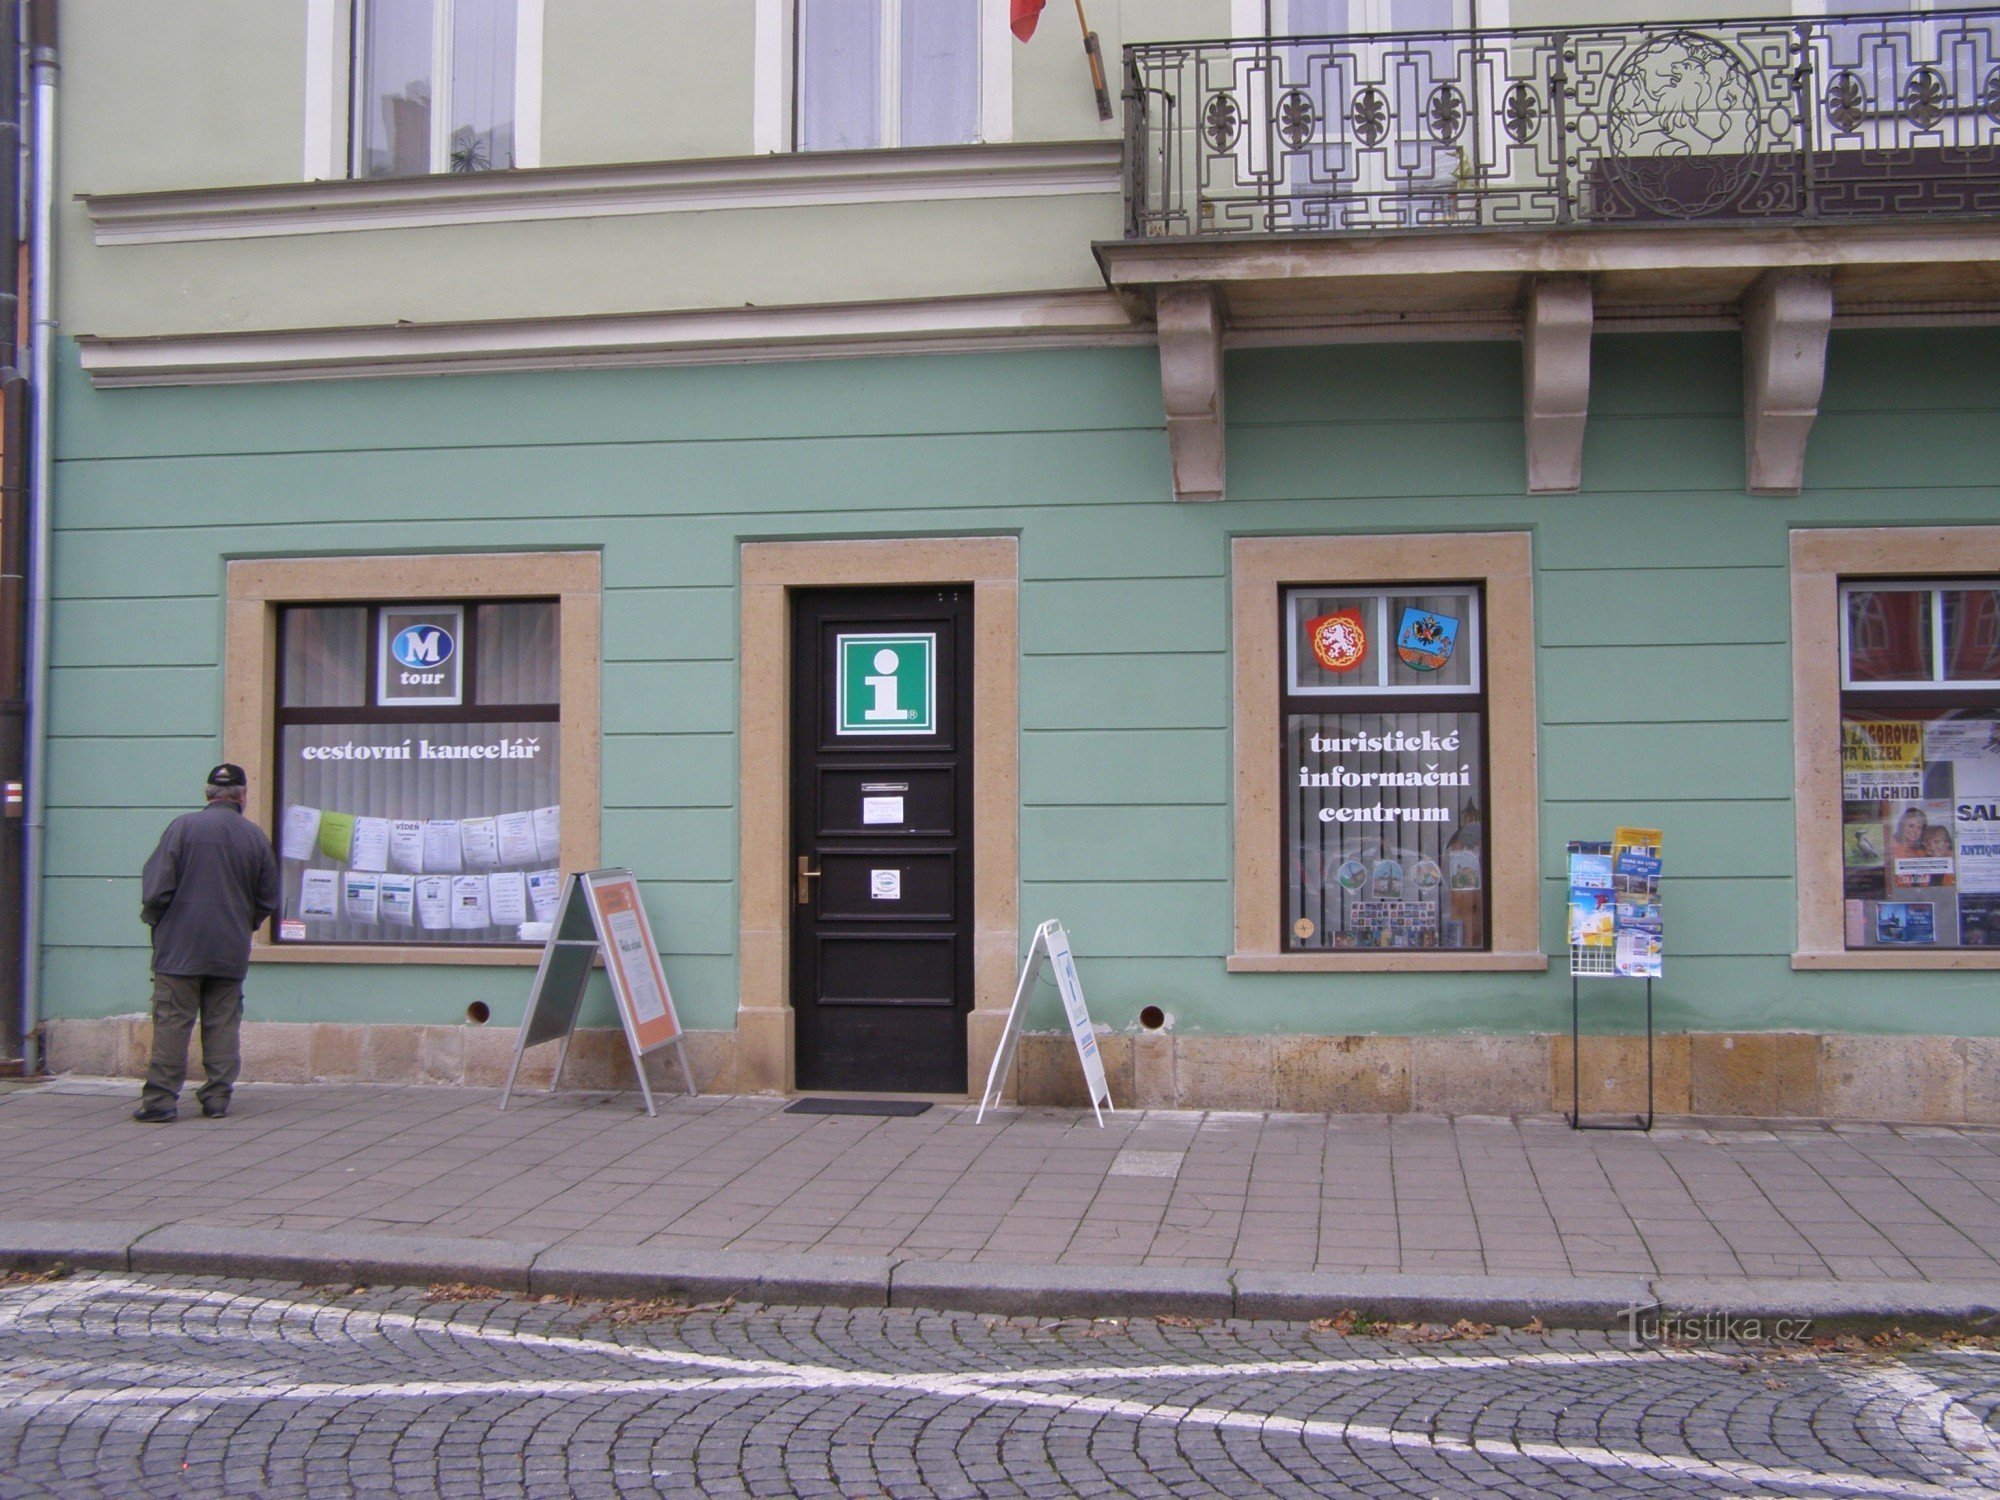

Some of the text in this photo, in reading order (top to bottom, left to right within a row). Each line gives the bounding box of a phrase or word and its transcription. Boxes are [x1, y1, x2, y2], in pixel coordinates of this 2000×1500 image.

[405, 631, 441, 662] M
[401, 671, 445, 685] tour
[302, 737, 541, 760] cestovní kancelář
[1309, 730, 1461, 753] turistické
[1298, 763, 1471, 788] informační
[1318, 802, 1450, 822] centrum
